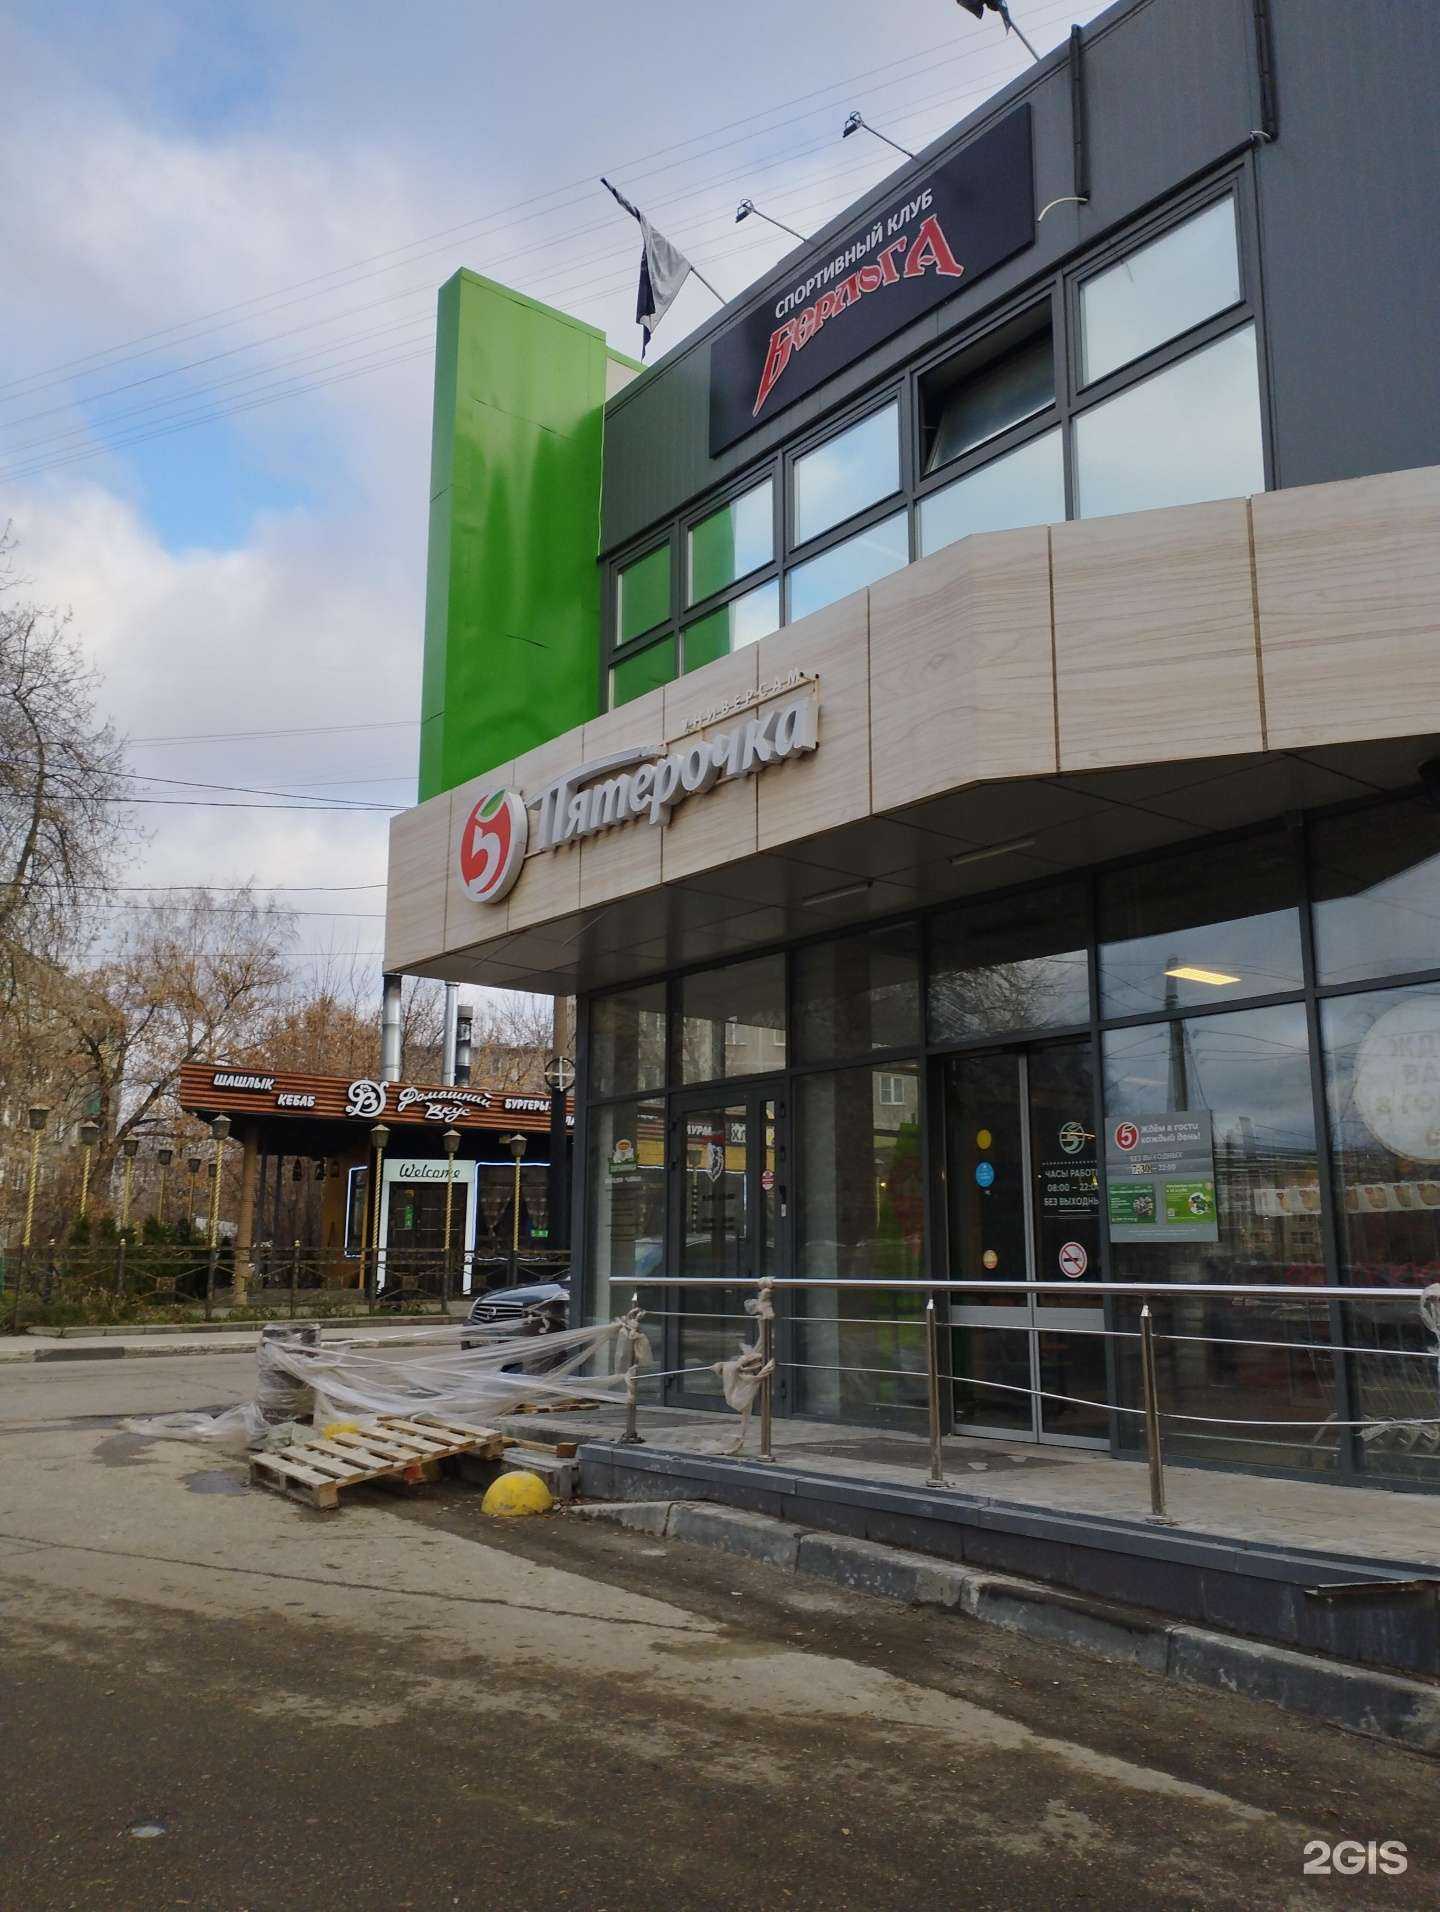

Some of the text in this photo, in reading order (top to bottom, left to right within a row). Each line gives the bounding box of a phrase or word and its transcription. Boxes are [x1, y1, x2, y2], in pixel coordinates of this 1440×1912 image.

[775, 188, 933, 319] СПОРТИВНЫЙ КЛУБ
[213, 1073, 276, 1091] ШАШЛЫК
[277, 1093, 316, 1107] КЕБАБ
[399, 1163, 461, 1179] Welcome
[1045, 1170, 1069, 1178] ЧАСЫ
[1044, 1197, 1058, 1206] БЕЗ
